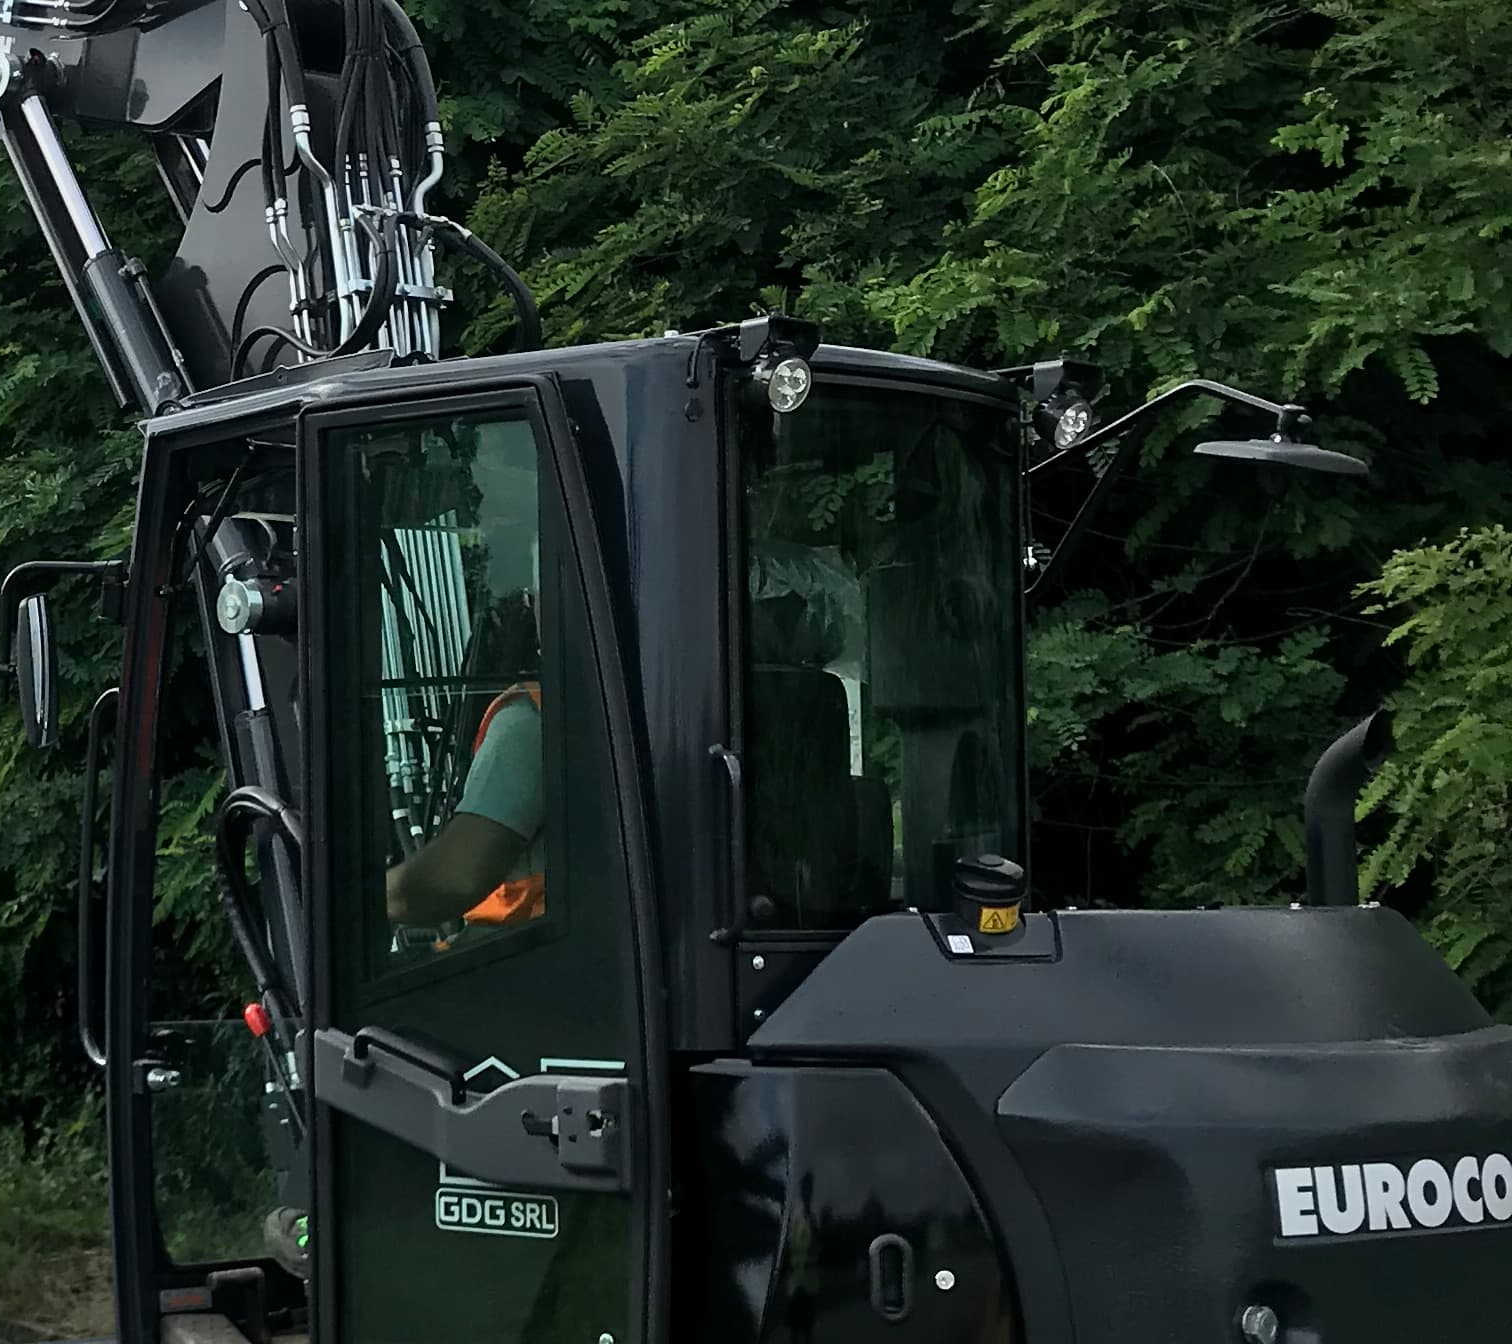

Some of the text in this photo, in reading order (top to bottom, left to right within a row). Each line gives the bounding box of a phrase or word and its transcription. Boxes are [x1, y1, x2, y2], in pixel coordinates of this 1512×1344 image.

[439, 1196, 555, 1230] GDG SRL
[1274, 1153, 1512, 1237] EUROCO
